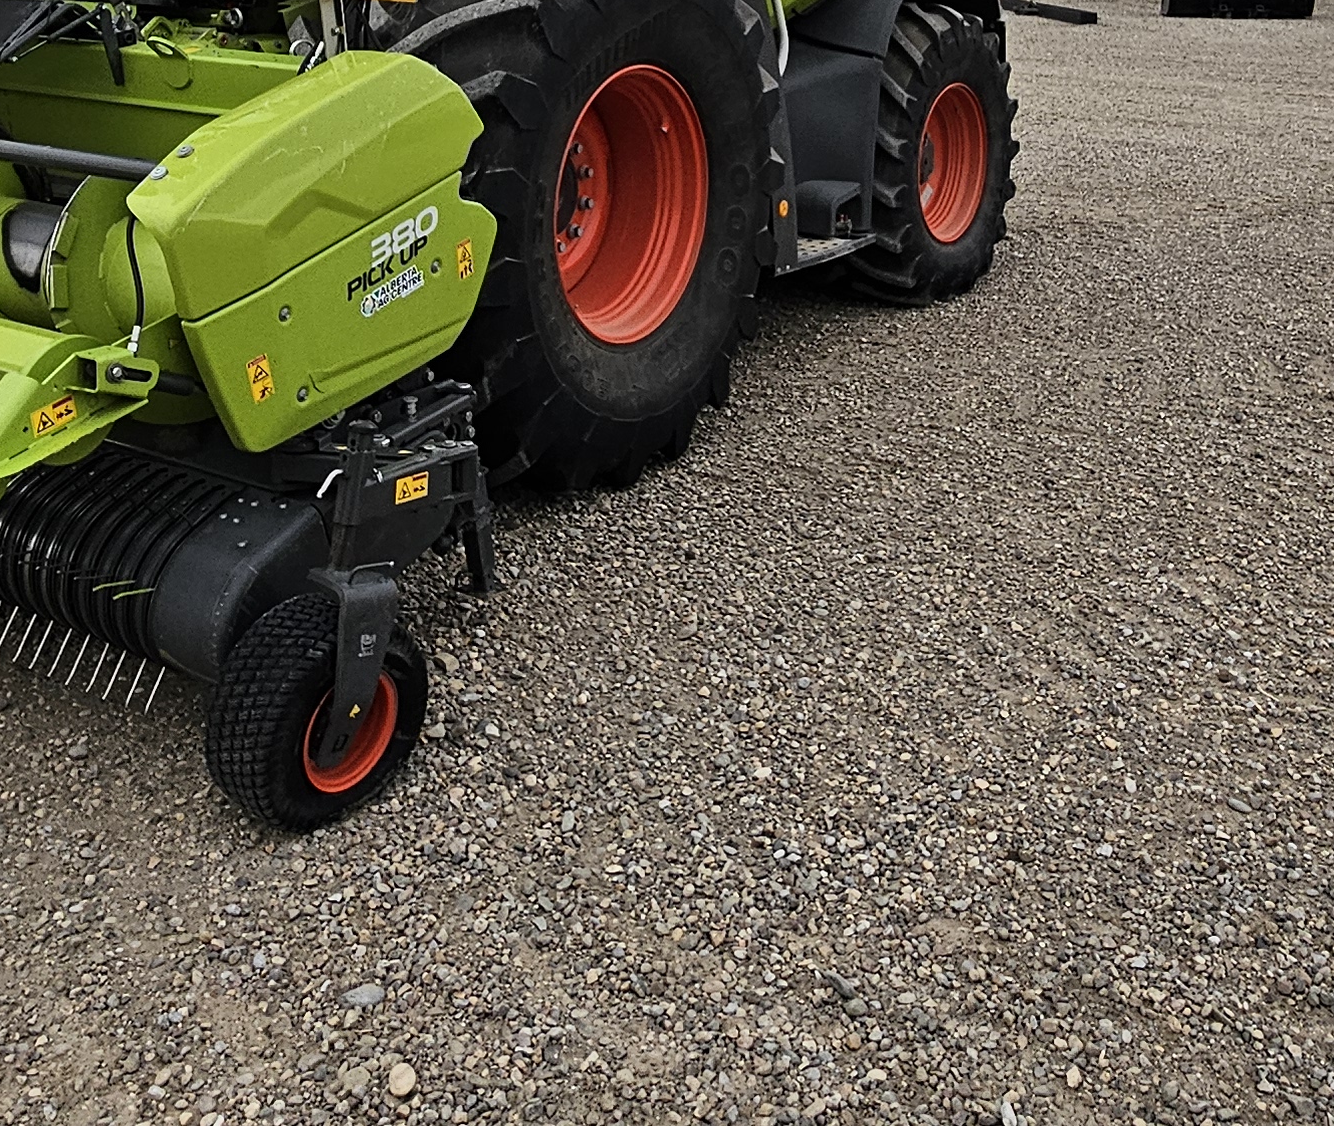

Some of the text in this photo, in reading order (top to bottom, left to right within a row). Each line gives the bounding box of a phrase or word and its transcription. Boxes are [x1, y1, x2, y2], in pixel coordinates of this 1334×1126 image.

[370, 205, 439, 268] 380
[346, 234, 428, 302] PICK UP
[377, 291, 390, 309] AG
[391, 272, 423, 300] CENTRE
[380, 266, 418, 295] ALBERTA
